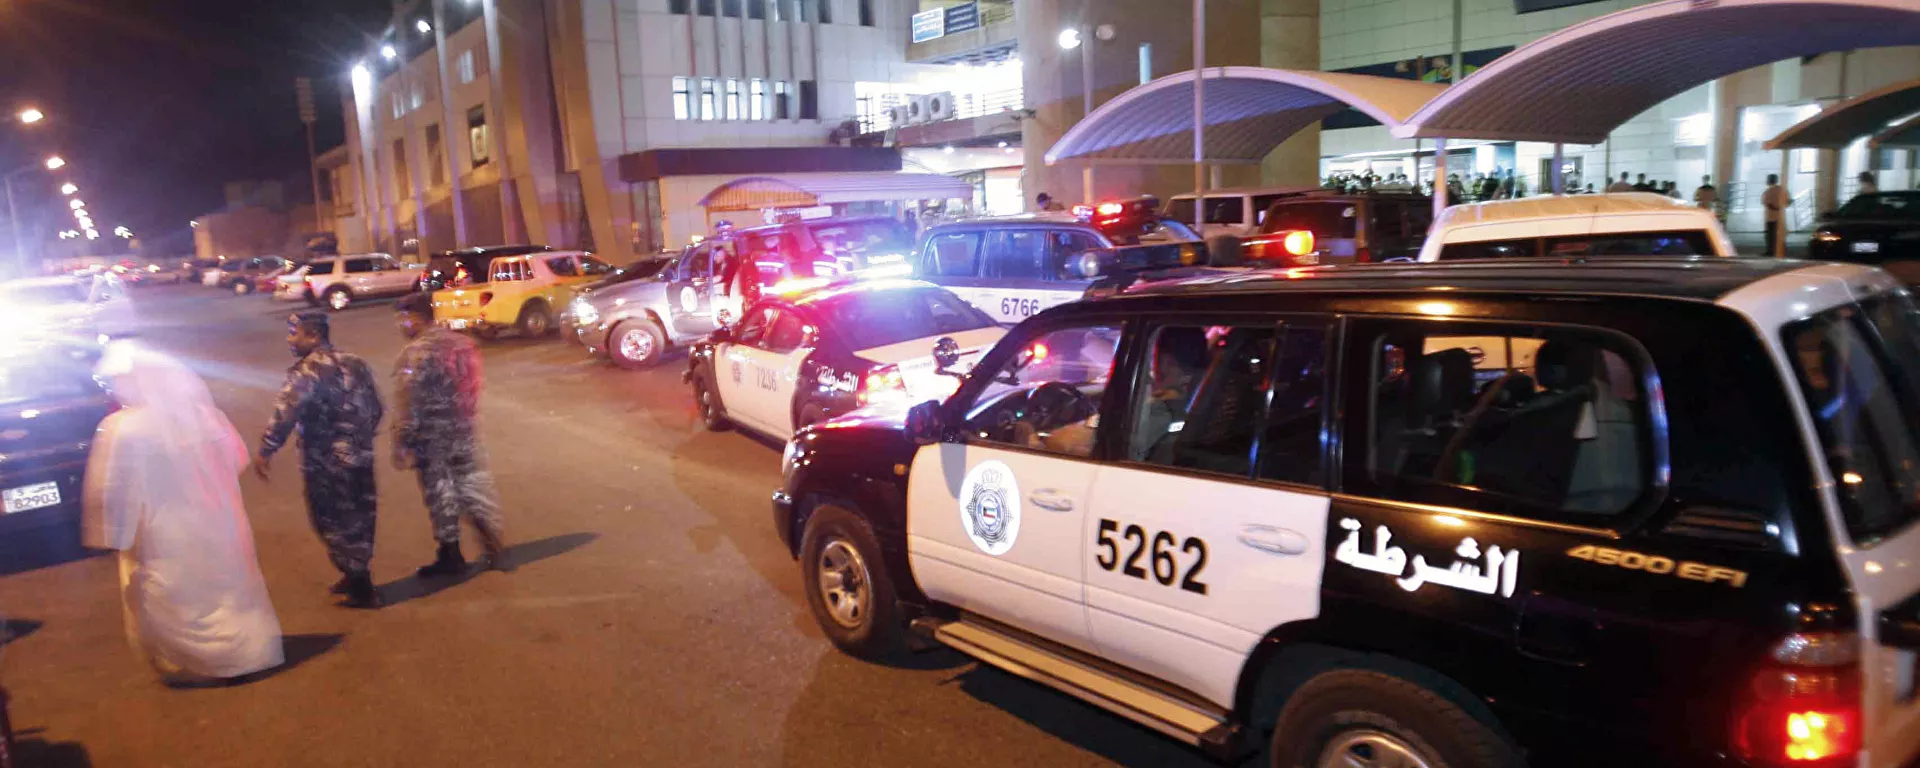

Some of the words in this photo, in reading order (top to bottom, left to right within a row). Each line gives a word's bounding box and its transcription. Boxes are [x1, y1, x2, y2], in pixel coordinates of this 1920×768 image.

[1001, 297, 1039, 316] 6766
[1096, 518, 1209, 595] 5262
[1335, 517, 1519, 598] الشرطة
[1567, 545, 1675, 574] 4500
[1677, 561, 1748, 588] EFI
